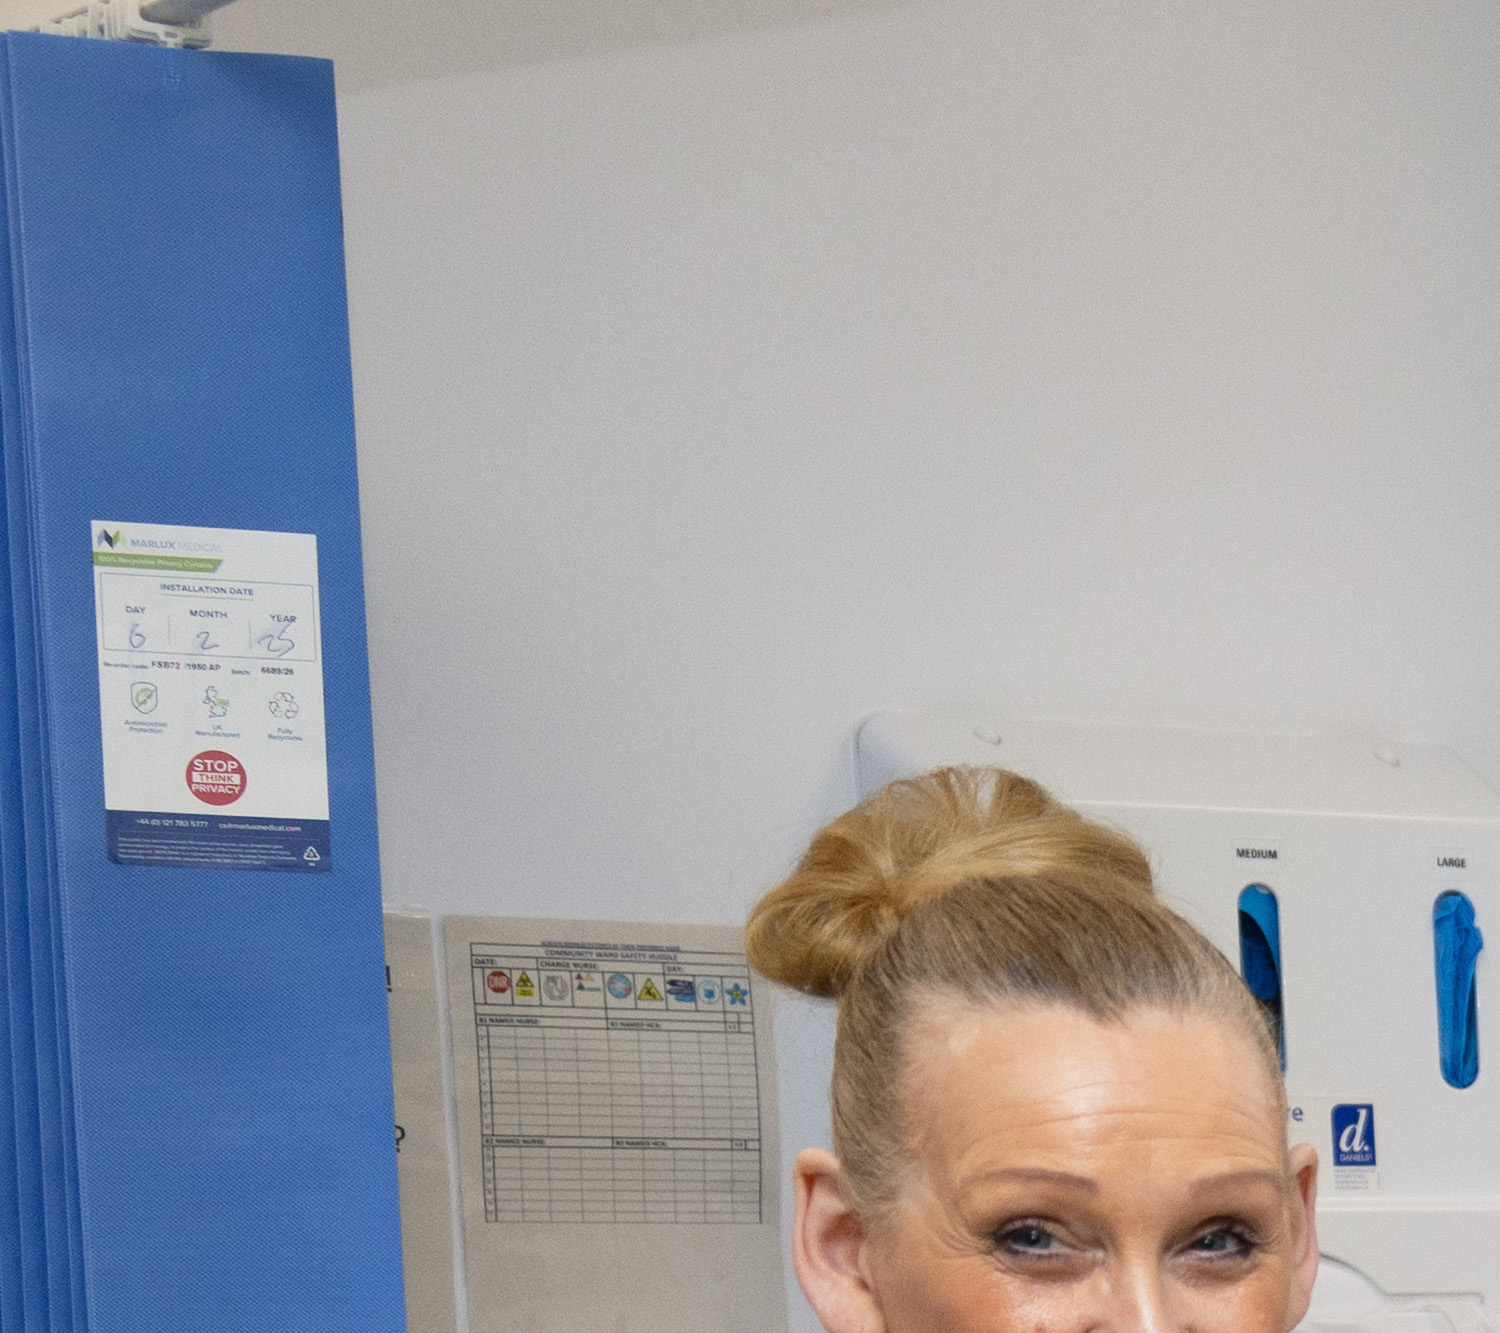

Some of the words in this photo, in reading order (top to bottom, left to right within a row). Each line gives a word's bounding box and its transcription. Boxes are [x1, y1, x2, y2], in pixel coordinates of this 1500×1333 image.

[130, 538, 176, 550] MARLUX
[160, 583, 227, 595] INSTALLATION
[229, 587, 254, 596] DATE
[125, 605, 146, 614] DAY
[189, 609, 228, 619] MONTH
[270, 613, 297, 623] YEAR
[193, 759, 239, 772] STOP
[199, 773, 235, 783] THINK
[192, 784, 241, 795] PRIVACY
[1236, 848, 1278, 860] MEDIUM
[1437, 857, 1466, 868] LARGE
